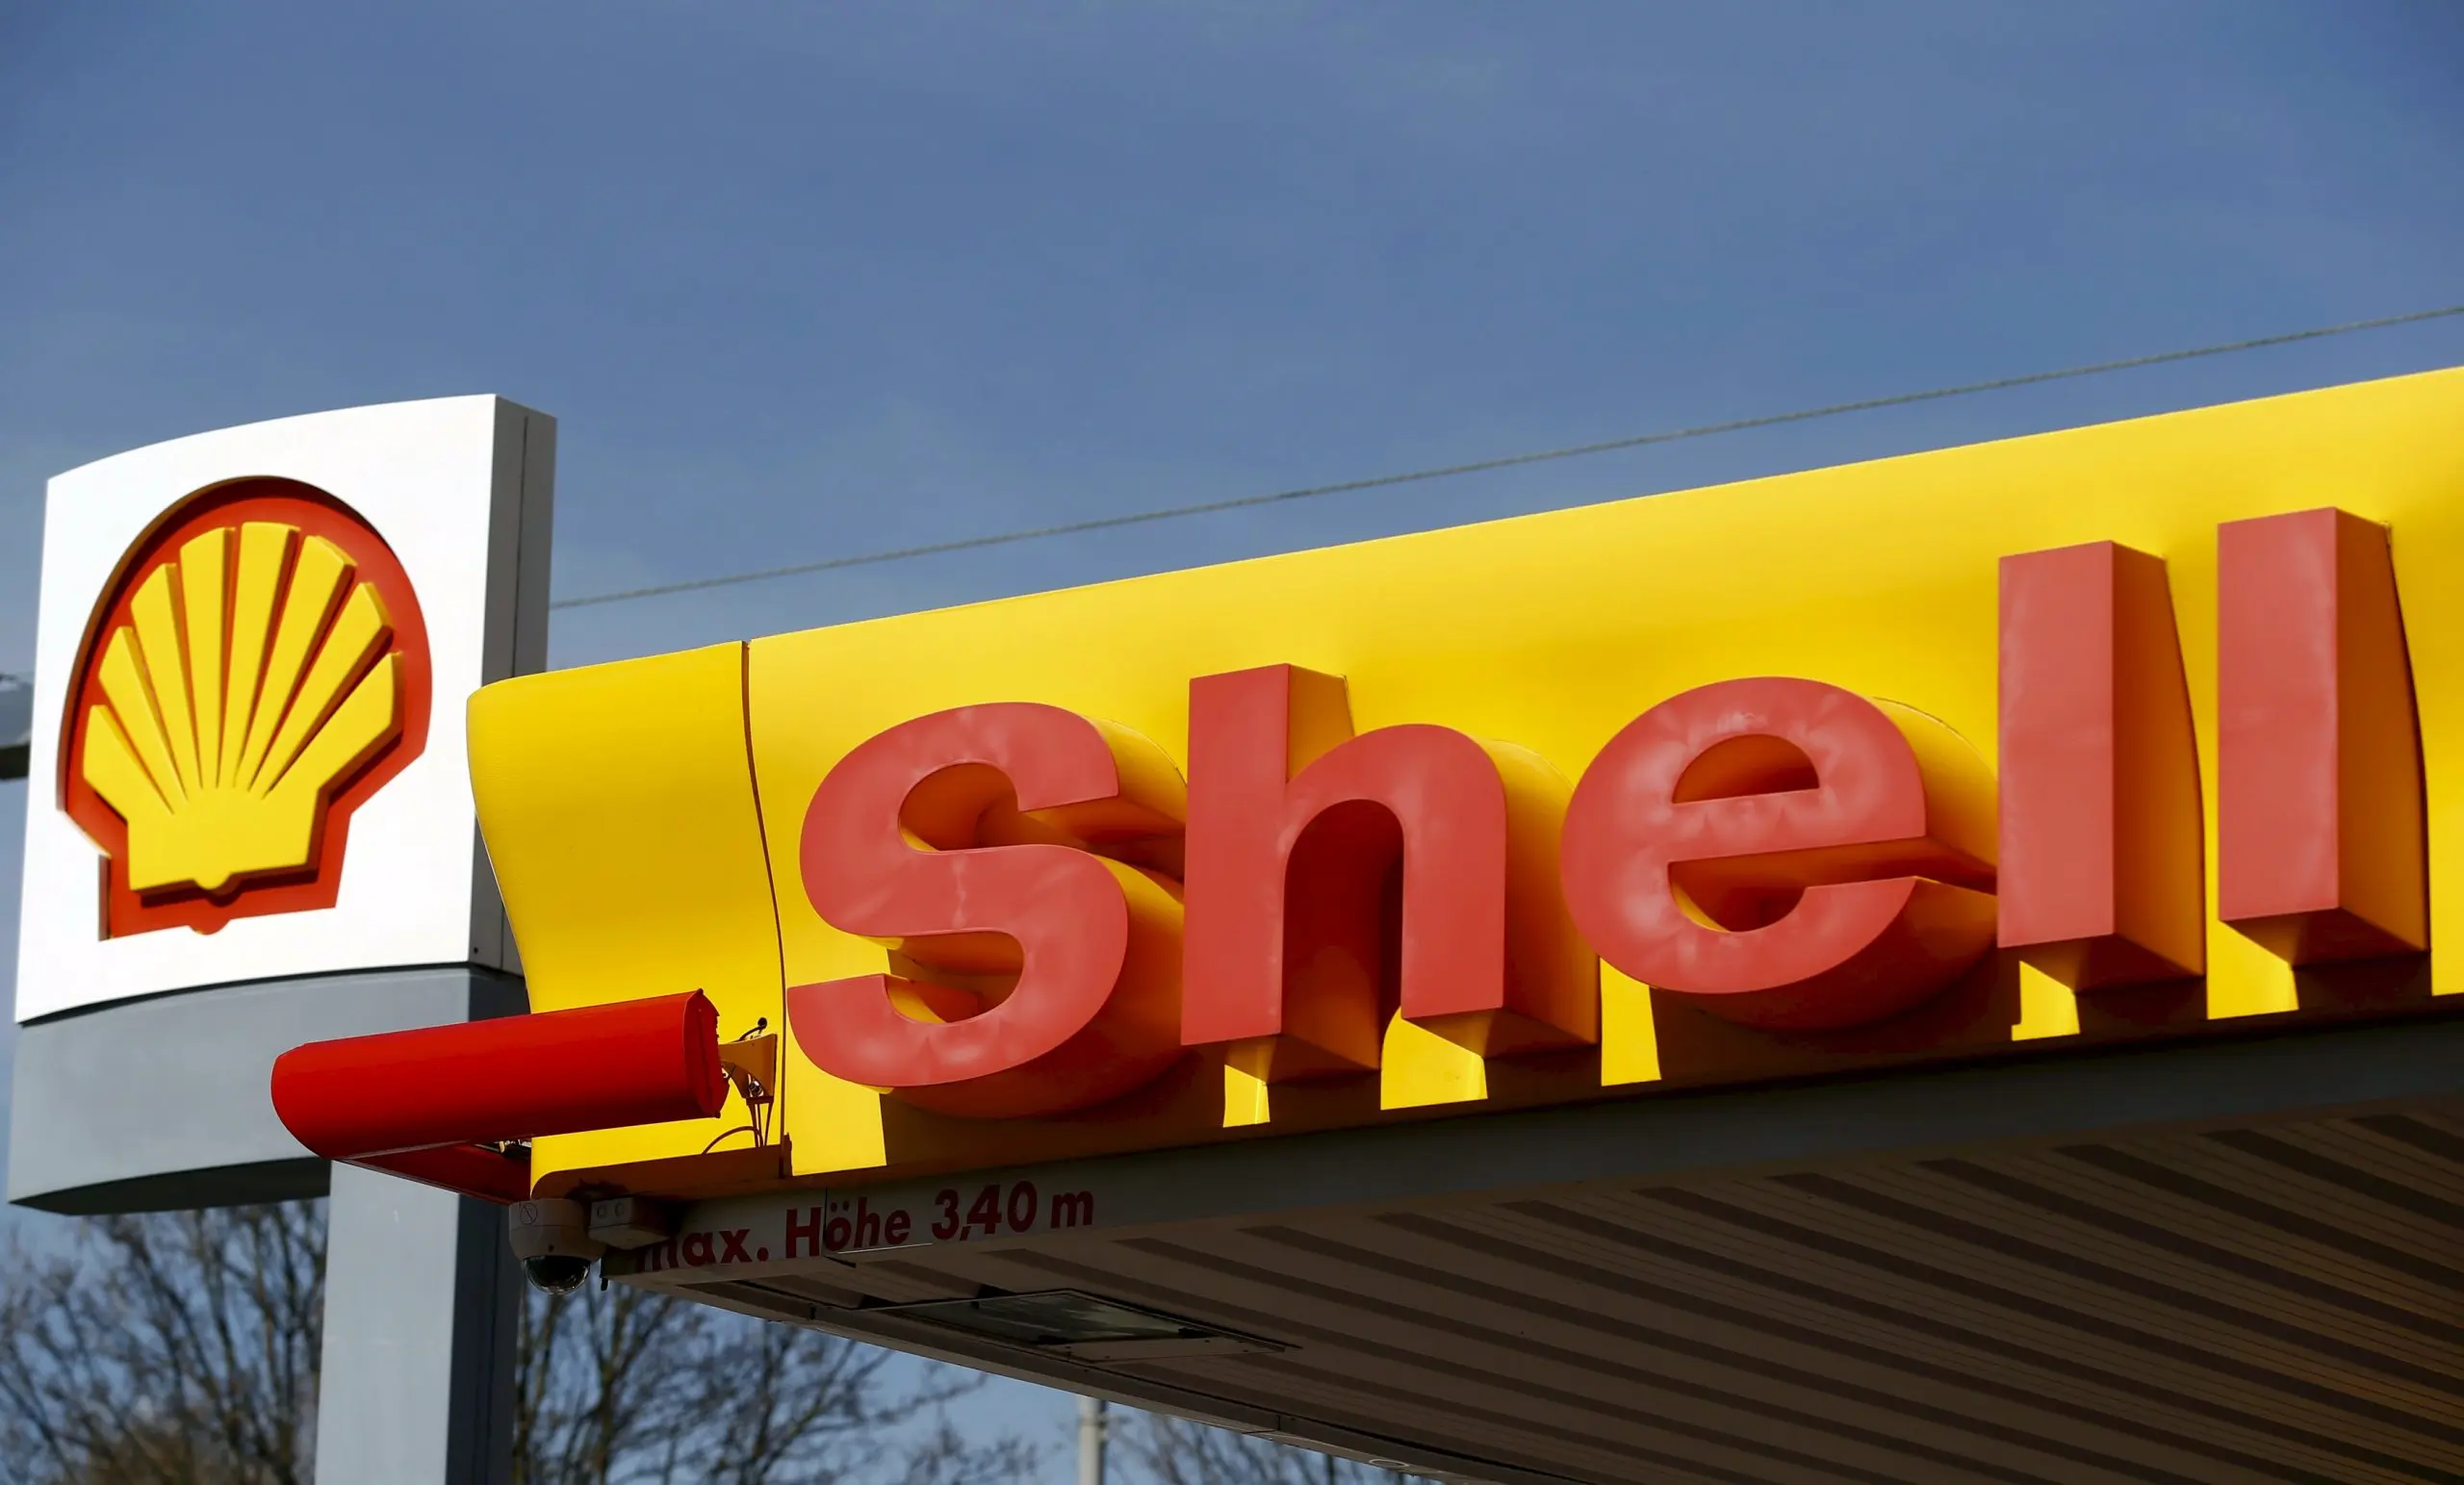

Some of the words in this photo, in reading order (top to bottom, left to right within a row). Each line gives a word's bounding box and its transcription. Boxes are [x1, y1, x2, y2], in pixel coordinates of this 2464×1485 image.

[785, 506, 2343, 1088] Shell
[785, 1196, 911, 1259] Höhe
[931, 1180, 1038, 1242] 3,40
[1050, 1191, 1093, 1229] m
